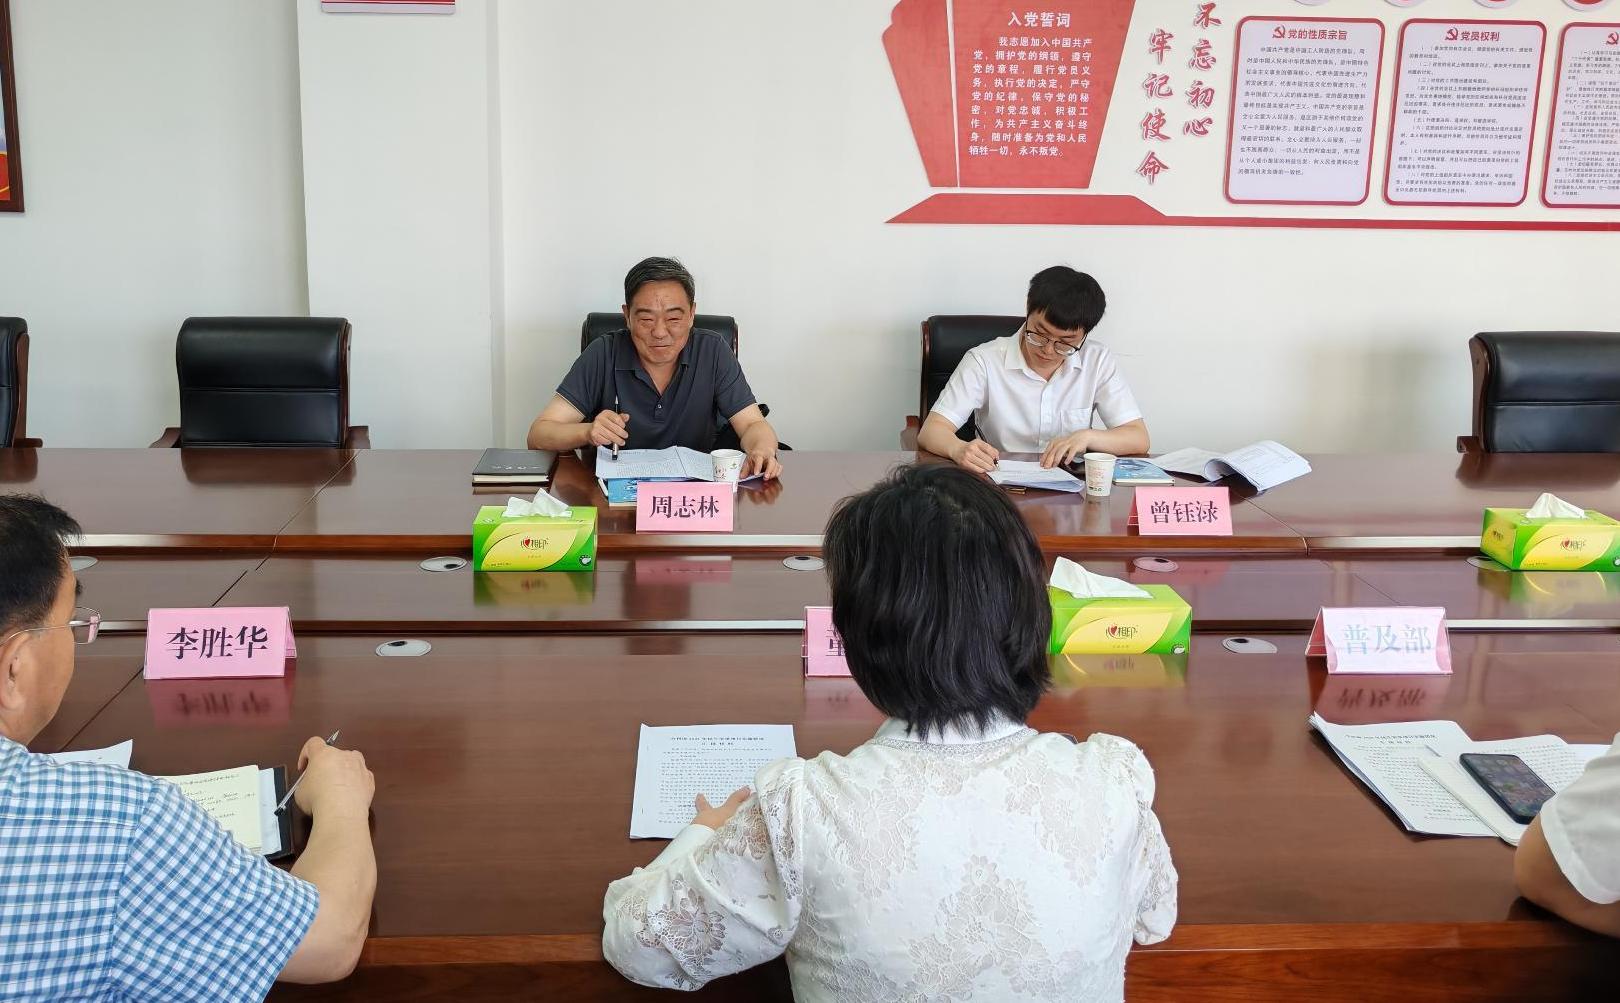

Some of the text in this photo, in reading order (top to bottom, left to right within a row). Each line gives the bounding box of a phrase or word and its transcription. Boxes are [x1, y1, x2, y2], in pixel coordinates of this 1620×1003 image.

[1008, 11, 1071, 28] 入党誓词
[998, 36, 1093, 48] 我志愿加入中国共产
[1287, 28, 1349, 41] 党的性质宗旨
[1460, 30, 1500, 42] 党员权利
[1183, 2, 1222, 137] 不忘初心
[1137, 28, 1175, 186] 牢记使命
[649, 494, 721, 520] 周志林
[1150, 500, 1219, 524] 曾钰渌
[166, 625, 268, 660] 李胜华
[1342, 624, 1432, 656] 普及部
